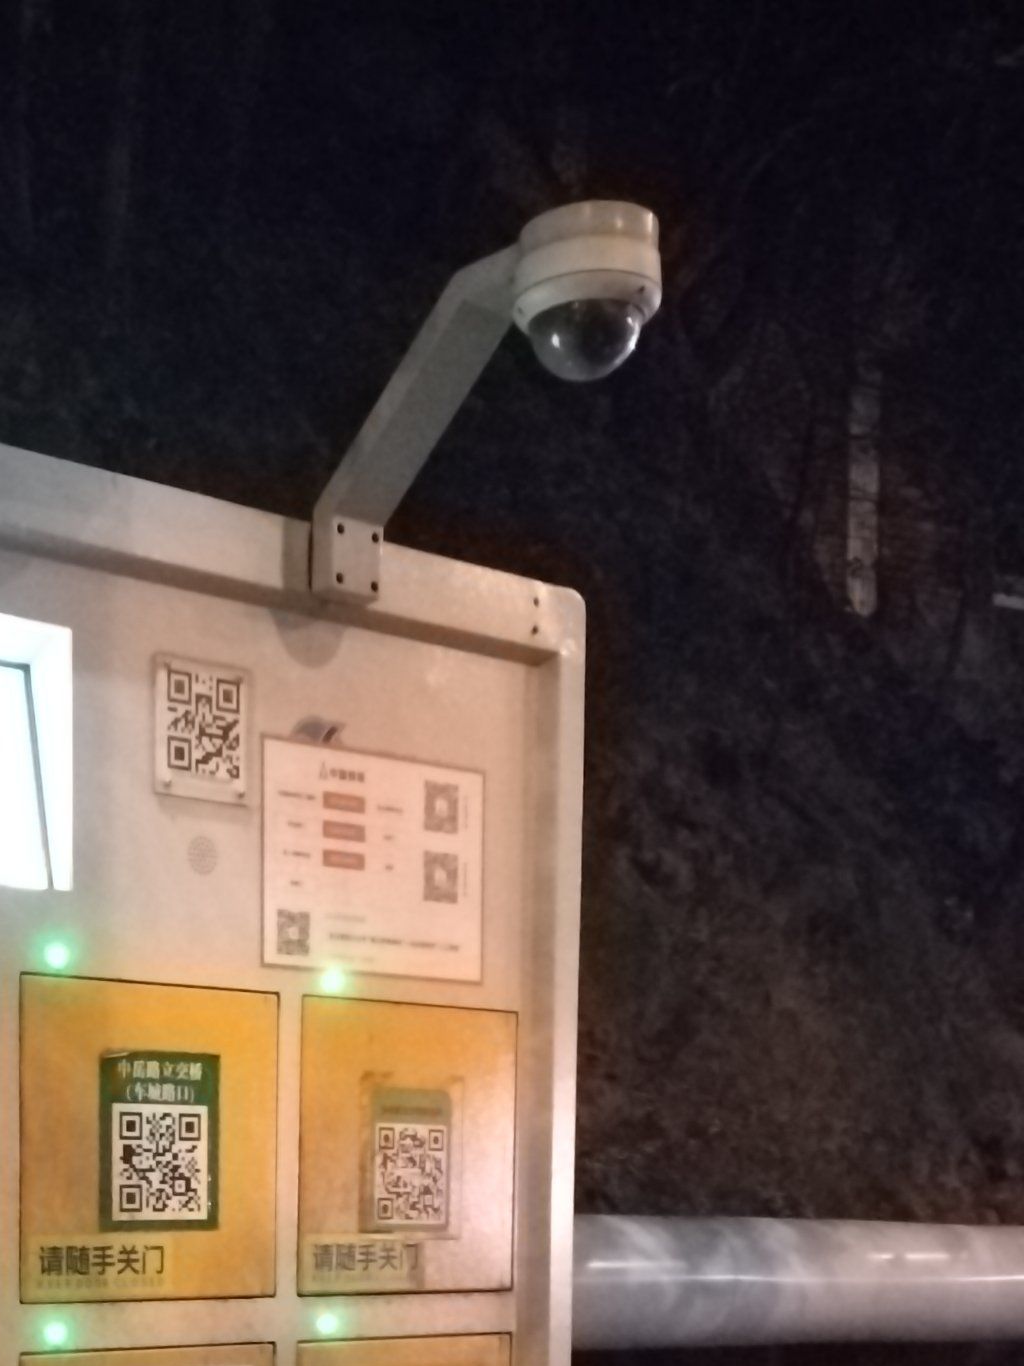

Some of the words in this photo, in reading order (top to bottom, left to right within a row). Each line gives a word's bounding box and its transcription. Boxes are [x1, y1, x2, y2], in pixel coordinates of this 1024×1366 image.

[39, 1244, 165, 1276] 请随手关门
[312, 1243, 418, 1272] 请随手关门
